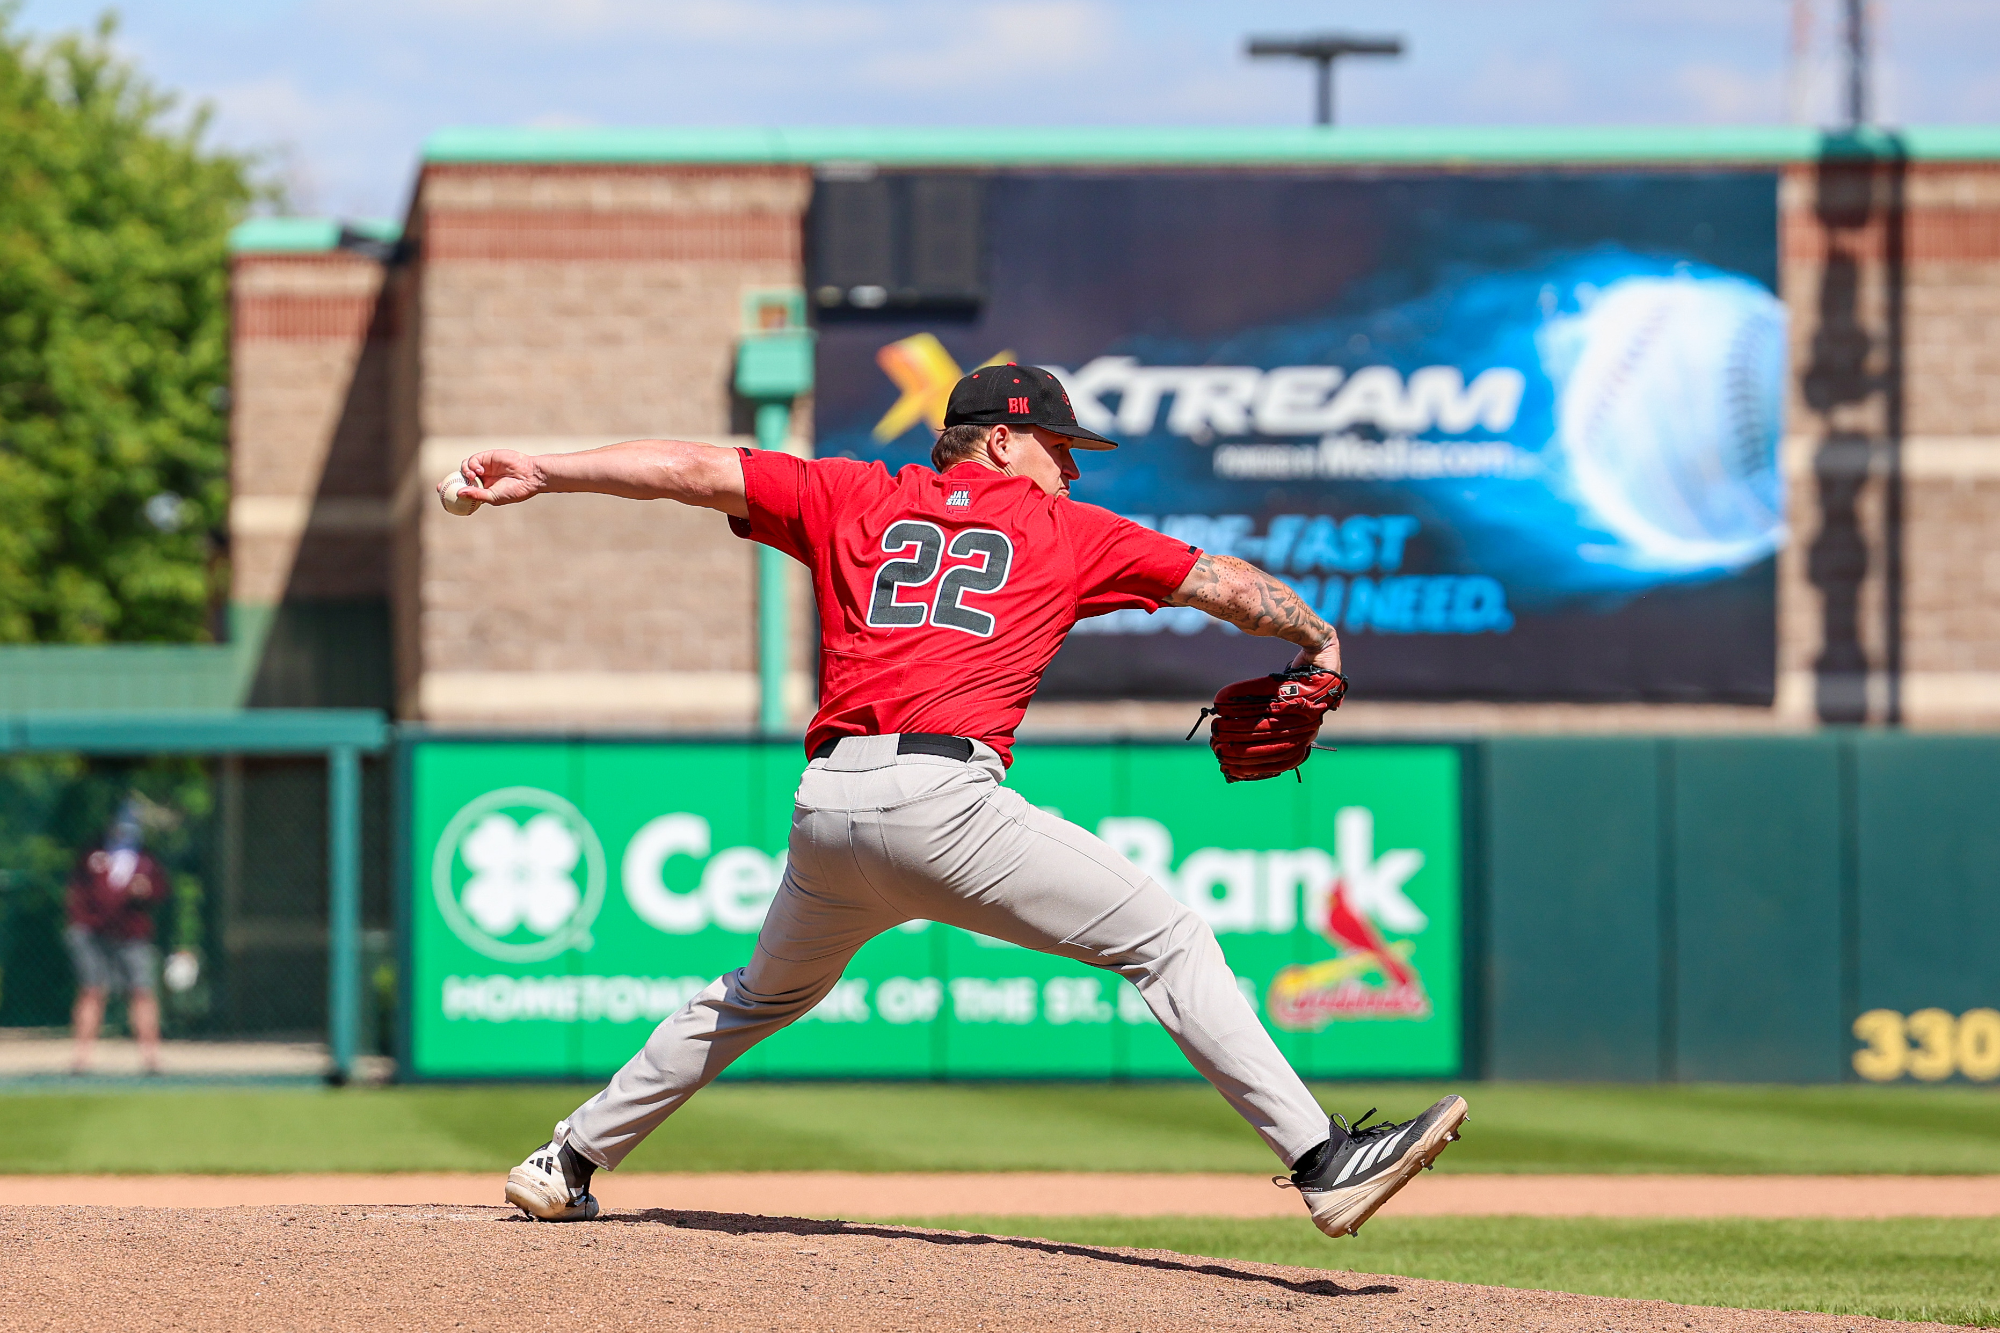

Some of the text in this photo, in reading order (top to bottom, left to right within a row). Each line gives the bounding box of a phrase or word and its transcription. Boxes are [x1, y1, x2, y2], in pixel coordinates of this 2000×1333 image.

[1008, 396, 1030, 414] BK
[945, 498, 971, 506] STATE
[950, 490, 970, 499] JAX
[866, 518, 1014, 638] 22
[1096, 805, 1429, 934] Bank
[875, 975, 945, 1024] OF
[950, 976, 1038, 1023] THE
[1852, 1006, 2000, 1082] 330
